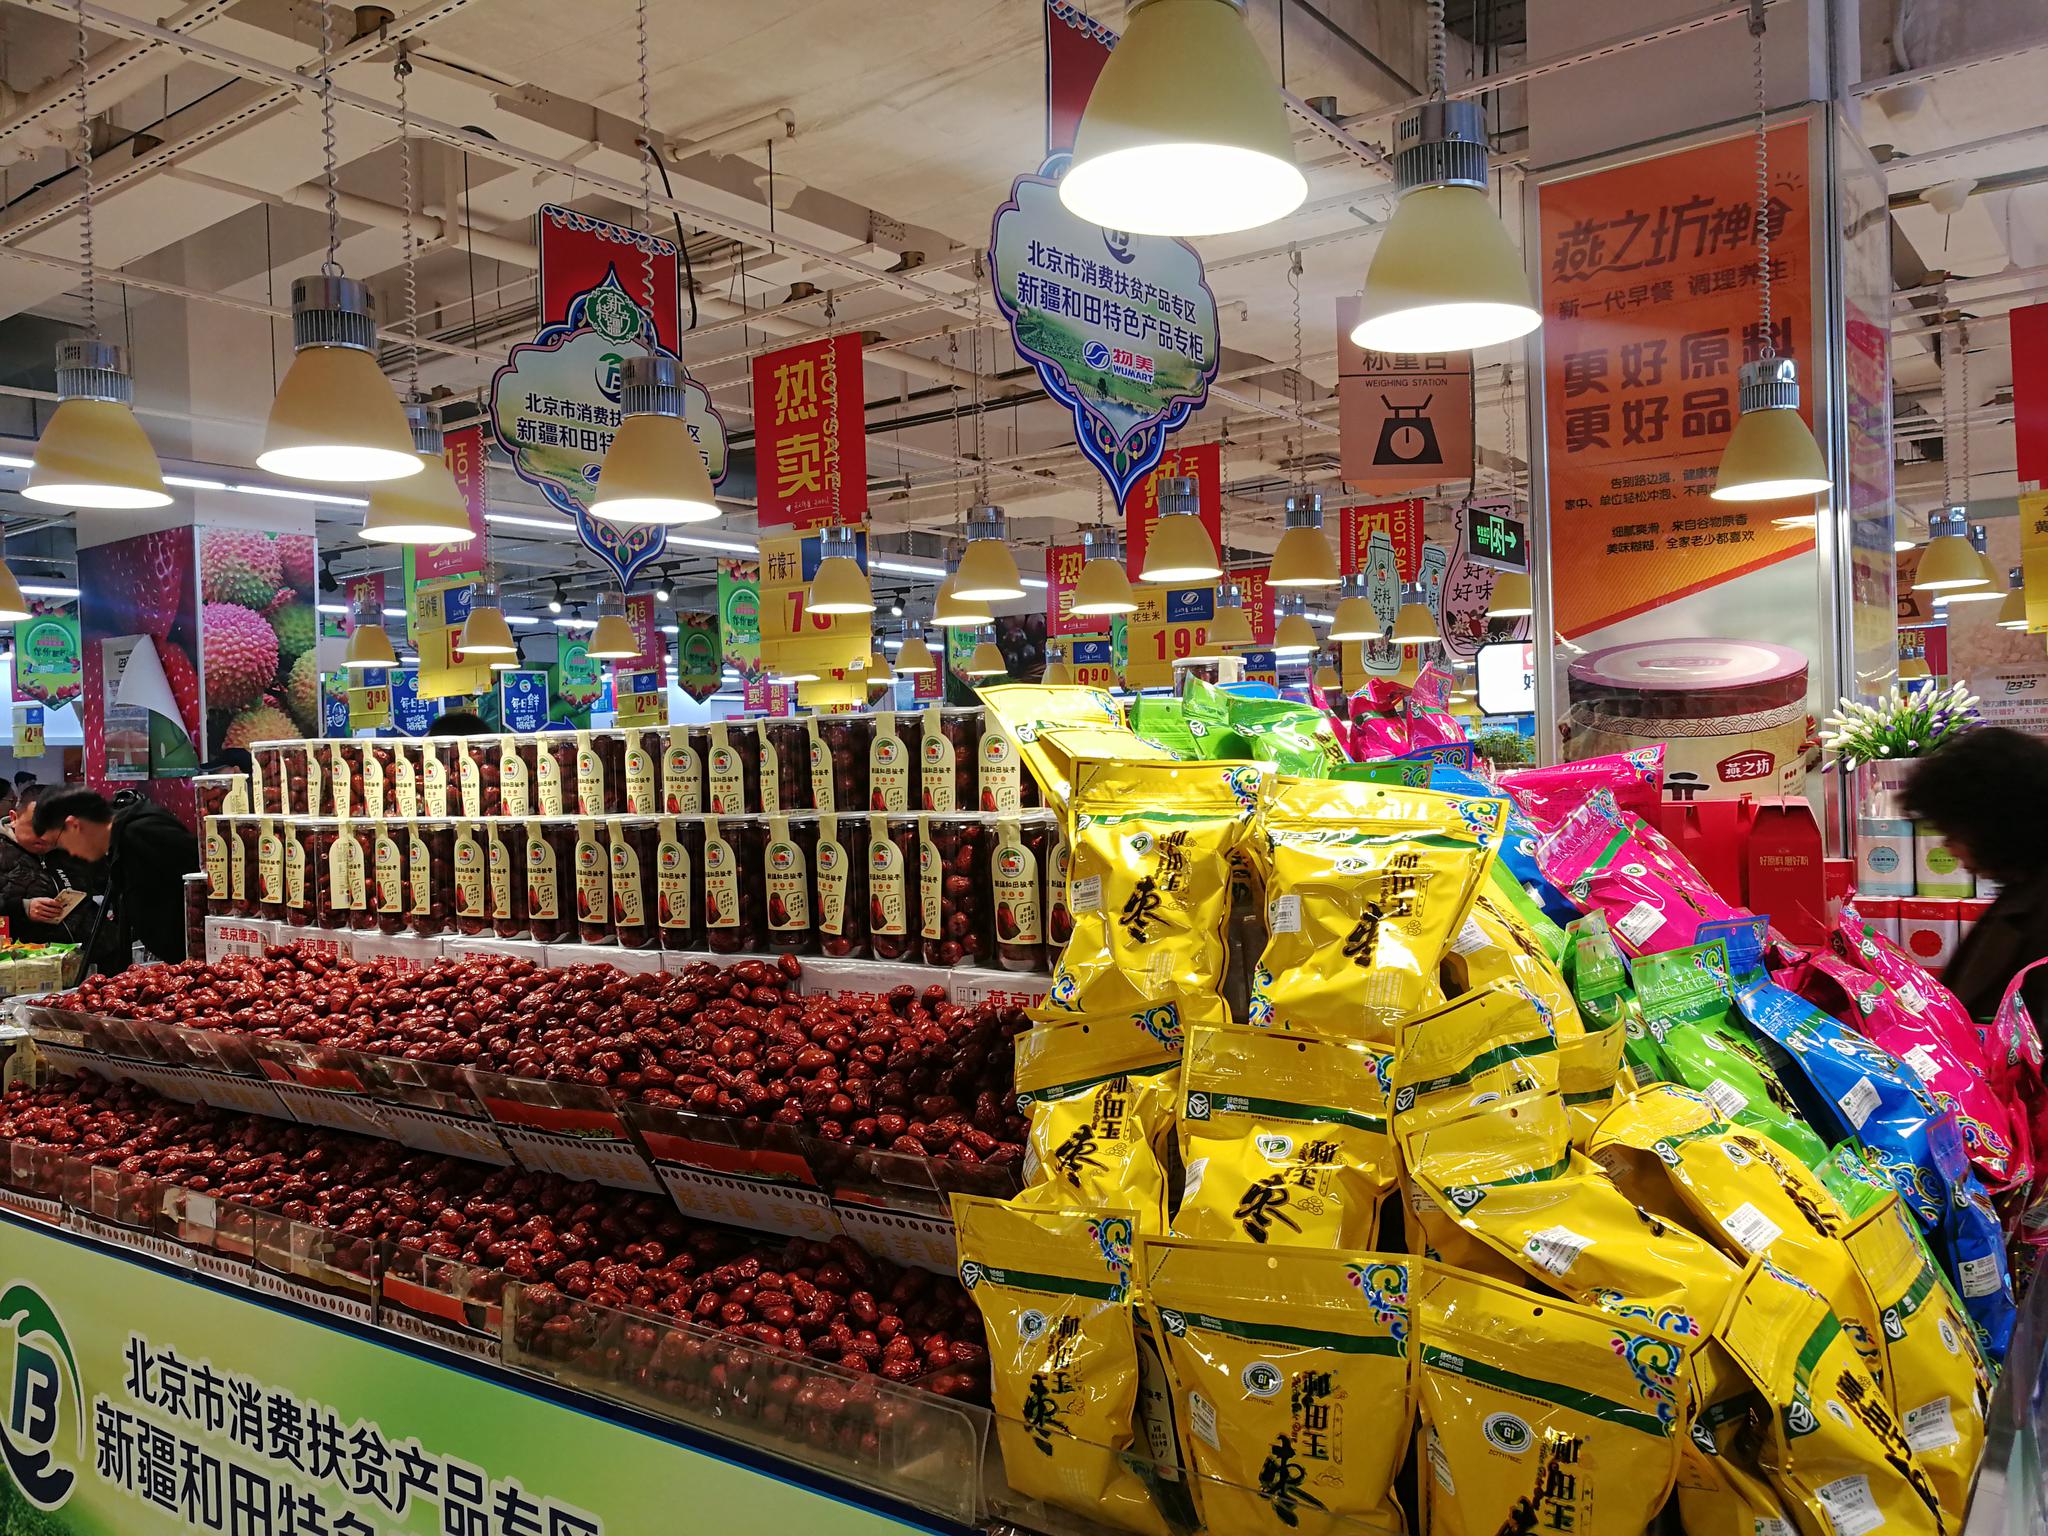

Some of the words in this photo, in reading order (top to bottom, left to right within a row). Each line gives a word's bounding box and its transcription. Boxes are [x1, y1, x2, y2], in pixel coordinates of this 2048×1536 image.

[1027, 239, 1197, 325] 北京市消费扶贫产品专区
[1558, 279, 1675, 321] 新一代早餐
[1017, 271, 1205, 363] 新疆和田特色产品专柜
[1112, 347, 1154, 373] 物美
[1112, 364, 1154, 384] WUMART
[1365, 378, 1409, 388] WEIGHING
[1412, 377, 1449, 387] STATION
[773, 359, 822, 499] 热卖
[1565, 387, 1733, 454] 更好品
[456, 442, 469, 488] HOT
[1393, 509, 1407, 542] HOT
[767, 552, 797, 581] 柠檬干
[1394, 546, 1407, 583] SAL
[1254, 575, 1264, 599] HOT
[638, 601, 646, 621] HOT
[1132, 611, 1161, 623] 花生米
[1254, 602, 1264, 634] SALE
[639, 627, 648, 656] SALE
[2005, 679, 2038, 692] 12325
[367, 689, 387, 710] 398
[637, 694, 658, 713] 298
[1724, 758, 1771, 780] 燕之坊
[219, 926, 259, 944] 燕京啤酒
[294, 938, 339, 956] 燕京啤酒
[1302, 1369, 1334, 1462] 和田玉
[123, 1334, 599, 1536] 北京市消费扶贫产品专区
[1503, 1426, 1515, 1441] GI
